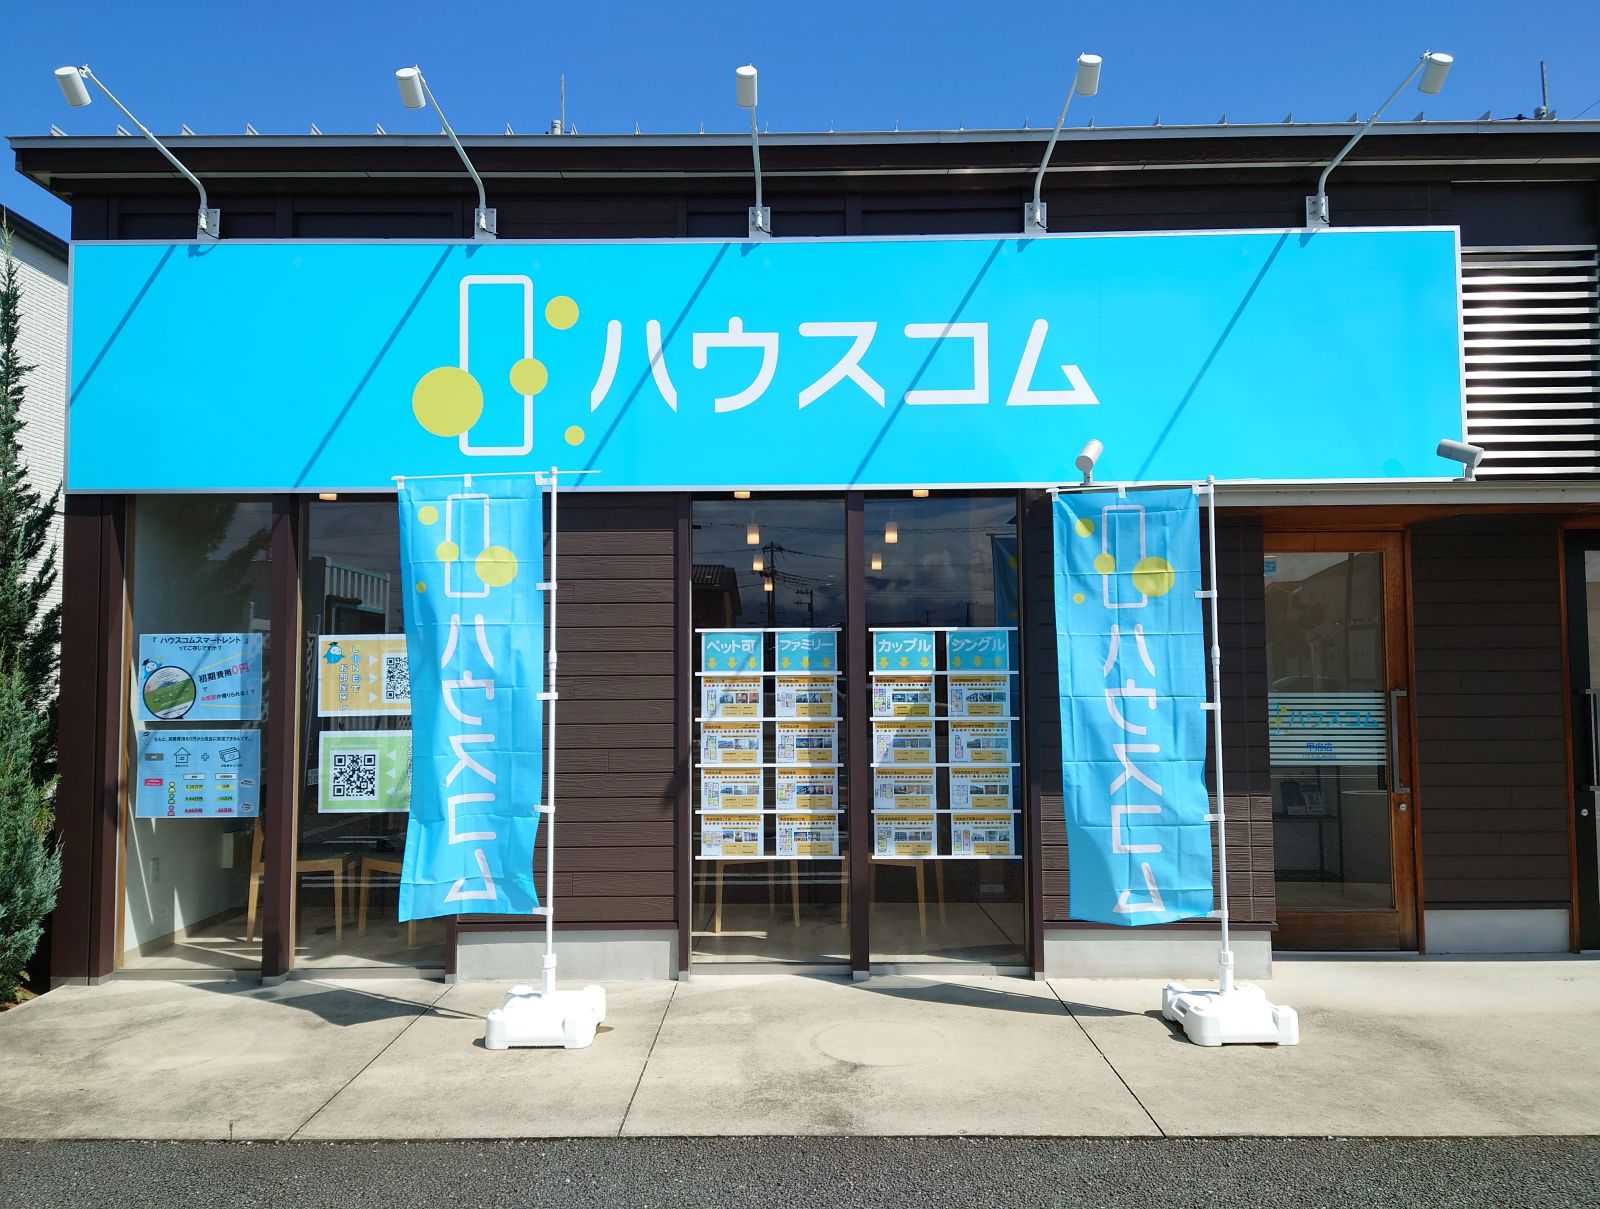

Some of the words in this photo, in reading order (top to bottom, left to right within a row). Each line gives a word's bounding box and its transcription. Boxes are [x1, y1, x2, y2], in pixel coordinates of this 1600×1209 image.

[591, 317, 1099, 412] ハウスコム
[706, 639, 756, 654] ペット可
[780, 638, 834, 651] ファミリー
[878, 638, 932, 653] カップル
[951, 636, 1006, 652] シングル
[1289, 711, 1379, 727] ハウスコム
